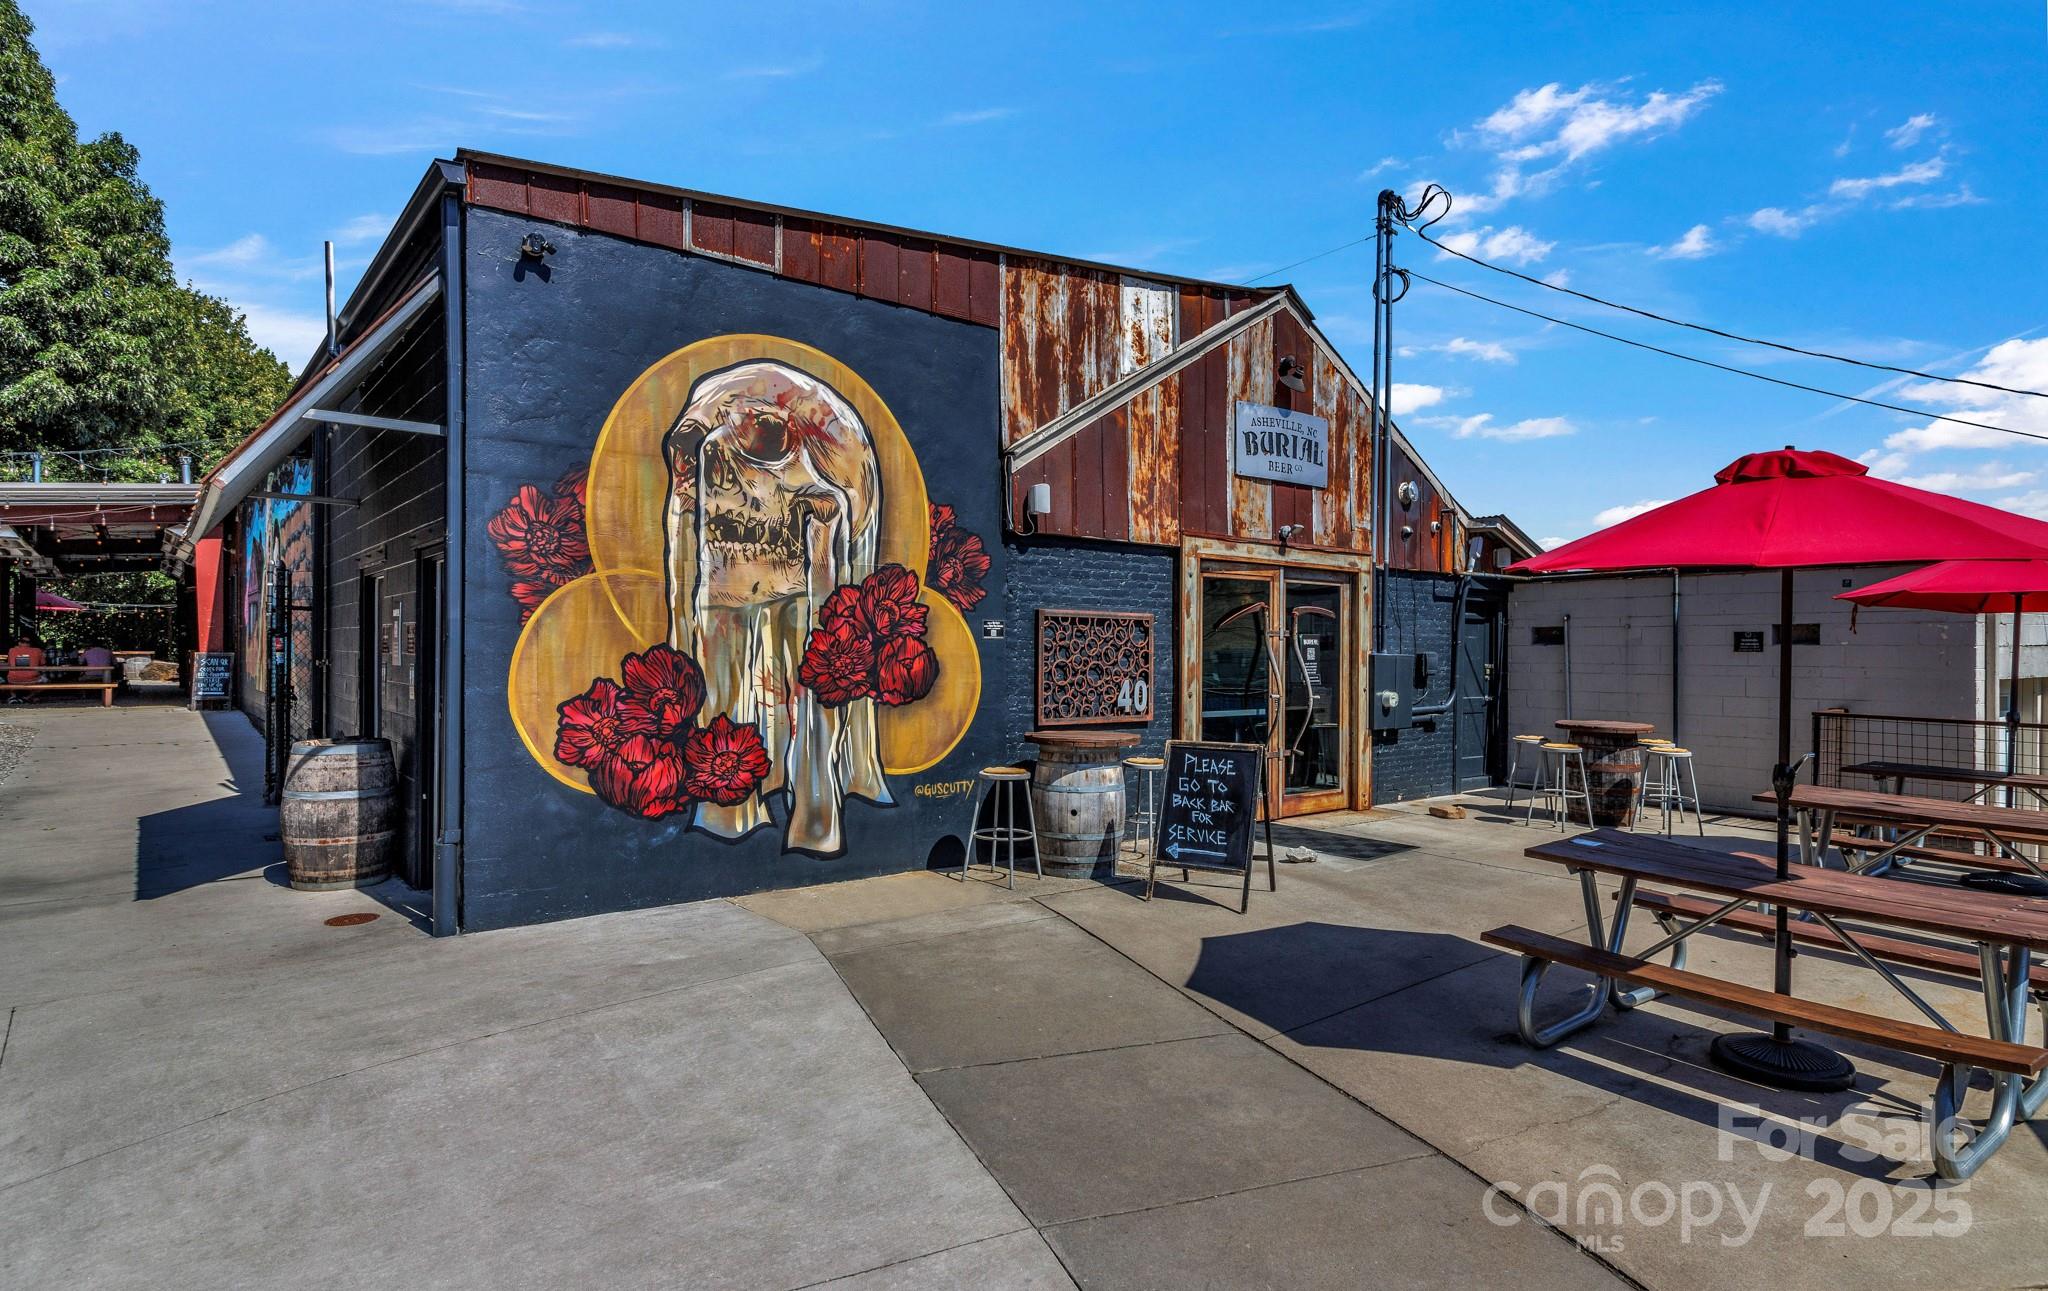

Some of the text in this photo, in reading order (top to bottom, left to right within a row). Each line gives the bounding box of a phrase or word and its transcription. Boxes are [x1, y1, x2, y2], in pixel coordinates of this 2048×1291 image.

[1251, 417, 1318, 438] ASHEVILLE, NC
[1242, 430, 1324, 467] BURIAL
[1268, 460, 1293, 474] BEER
[1117, 679, 1147, 712] 40
[1184, 753, 1236, 775] PLEASE
[914, 779, 975, 800] @GUSCUTTY
[1178, 777, 1228, 793] GO TO
[1172, 793, 1234, 813] BACK BAR
[1192, 810, 1213, 825] FOR
[1168, 823, 1227, 845] SERVICE
